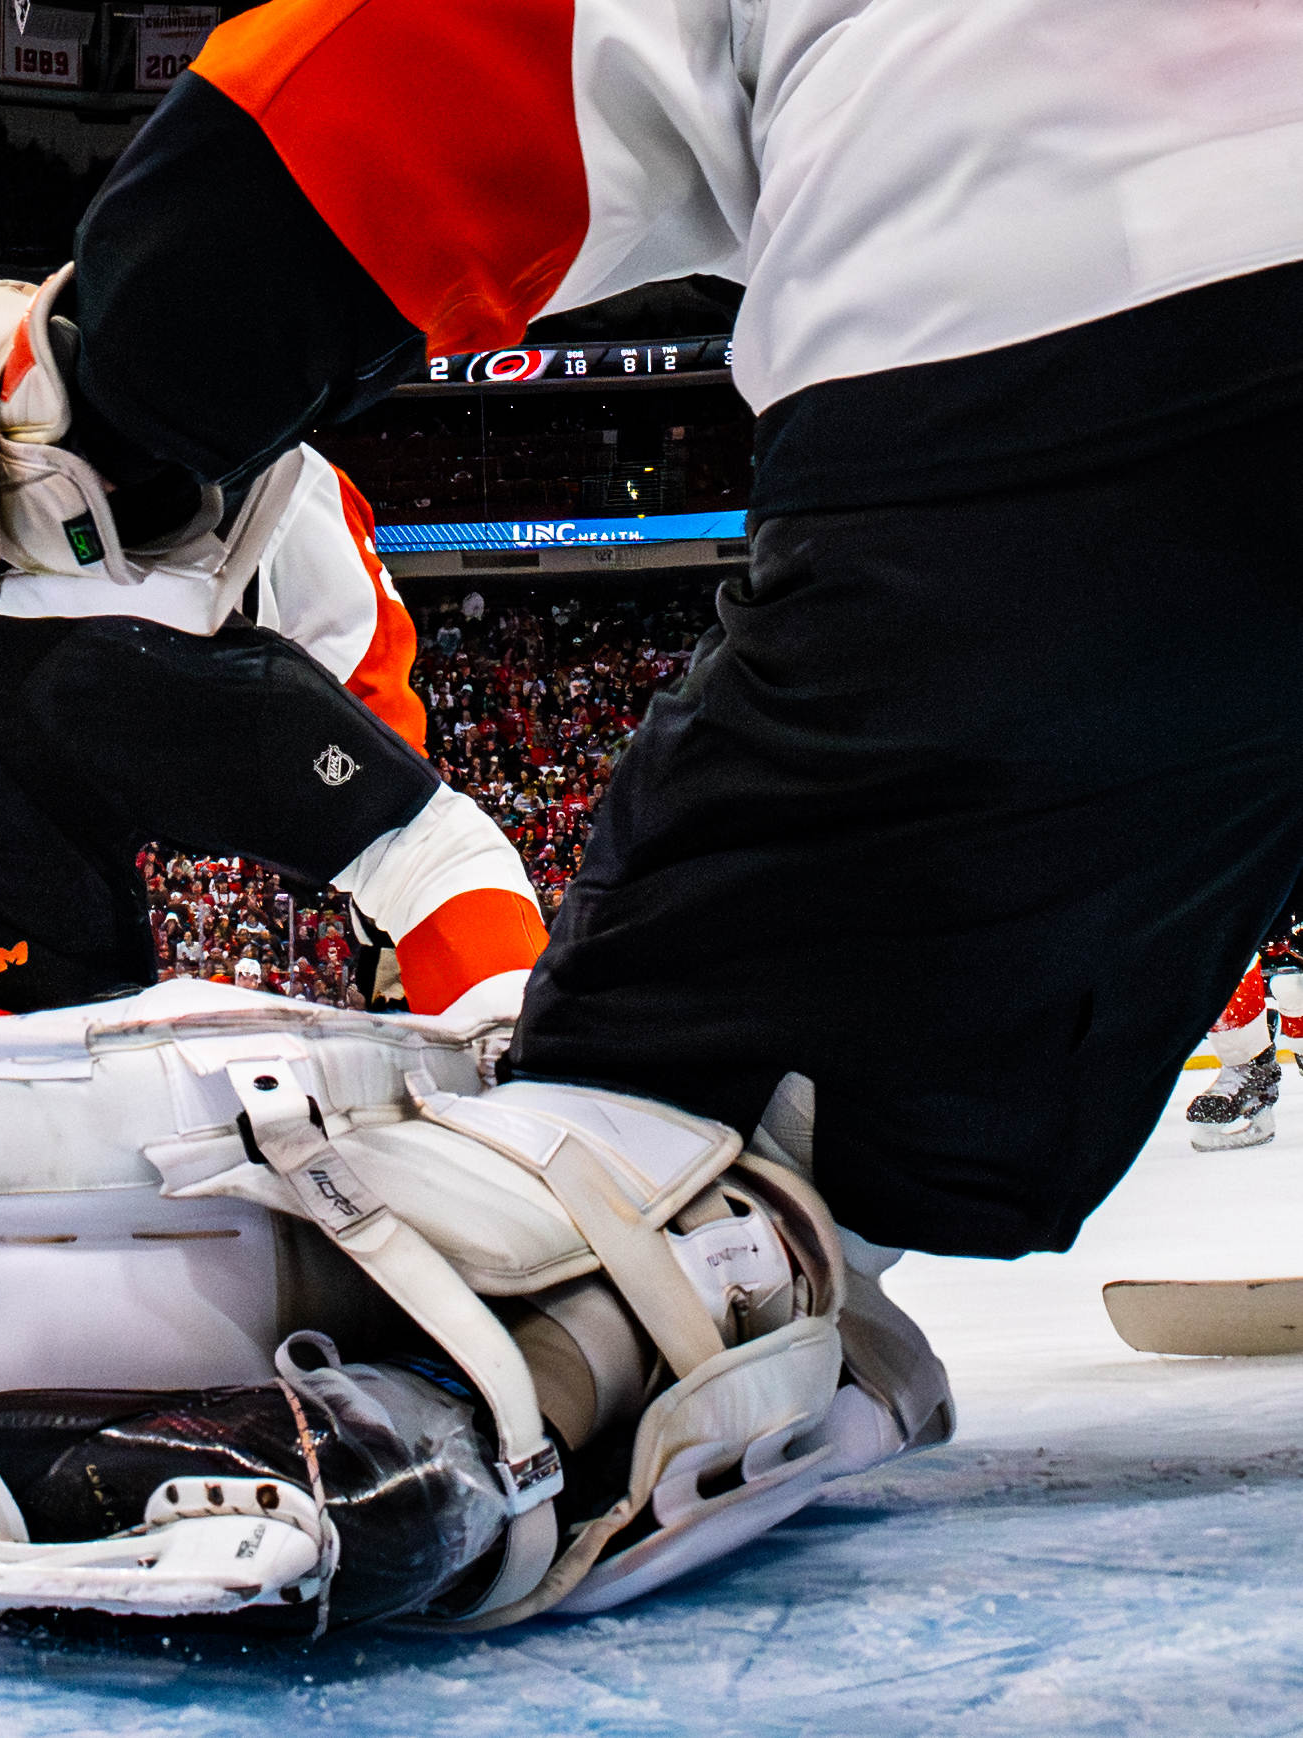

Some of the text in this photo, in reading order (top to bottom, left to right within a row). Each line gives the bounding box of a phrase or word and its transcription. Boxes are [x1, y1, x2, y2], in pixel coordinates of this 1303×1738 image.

[14, 47, 69, 75] 1989
[430, 357, 448, 380] 2
[565, 360, 587, 375] 18
[623, 355, 676, 373] 8 2
[512, 523, 576, 547] UNC
